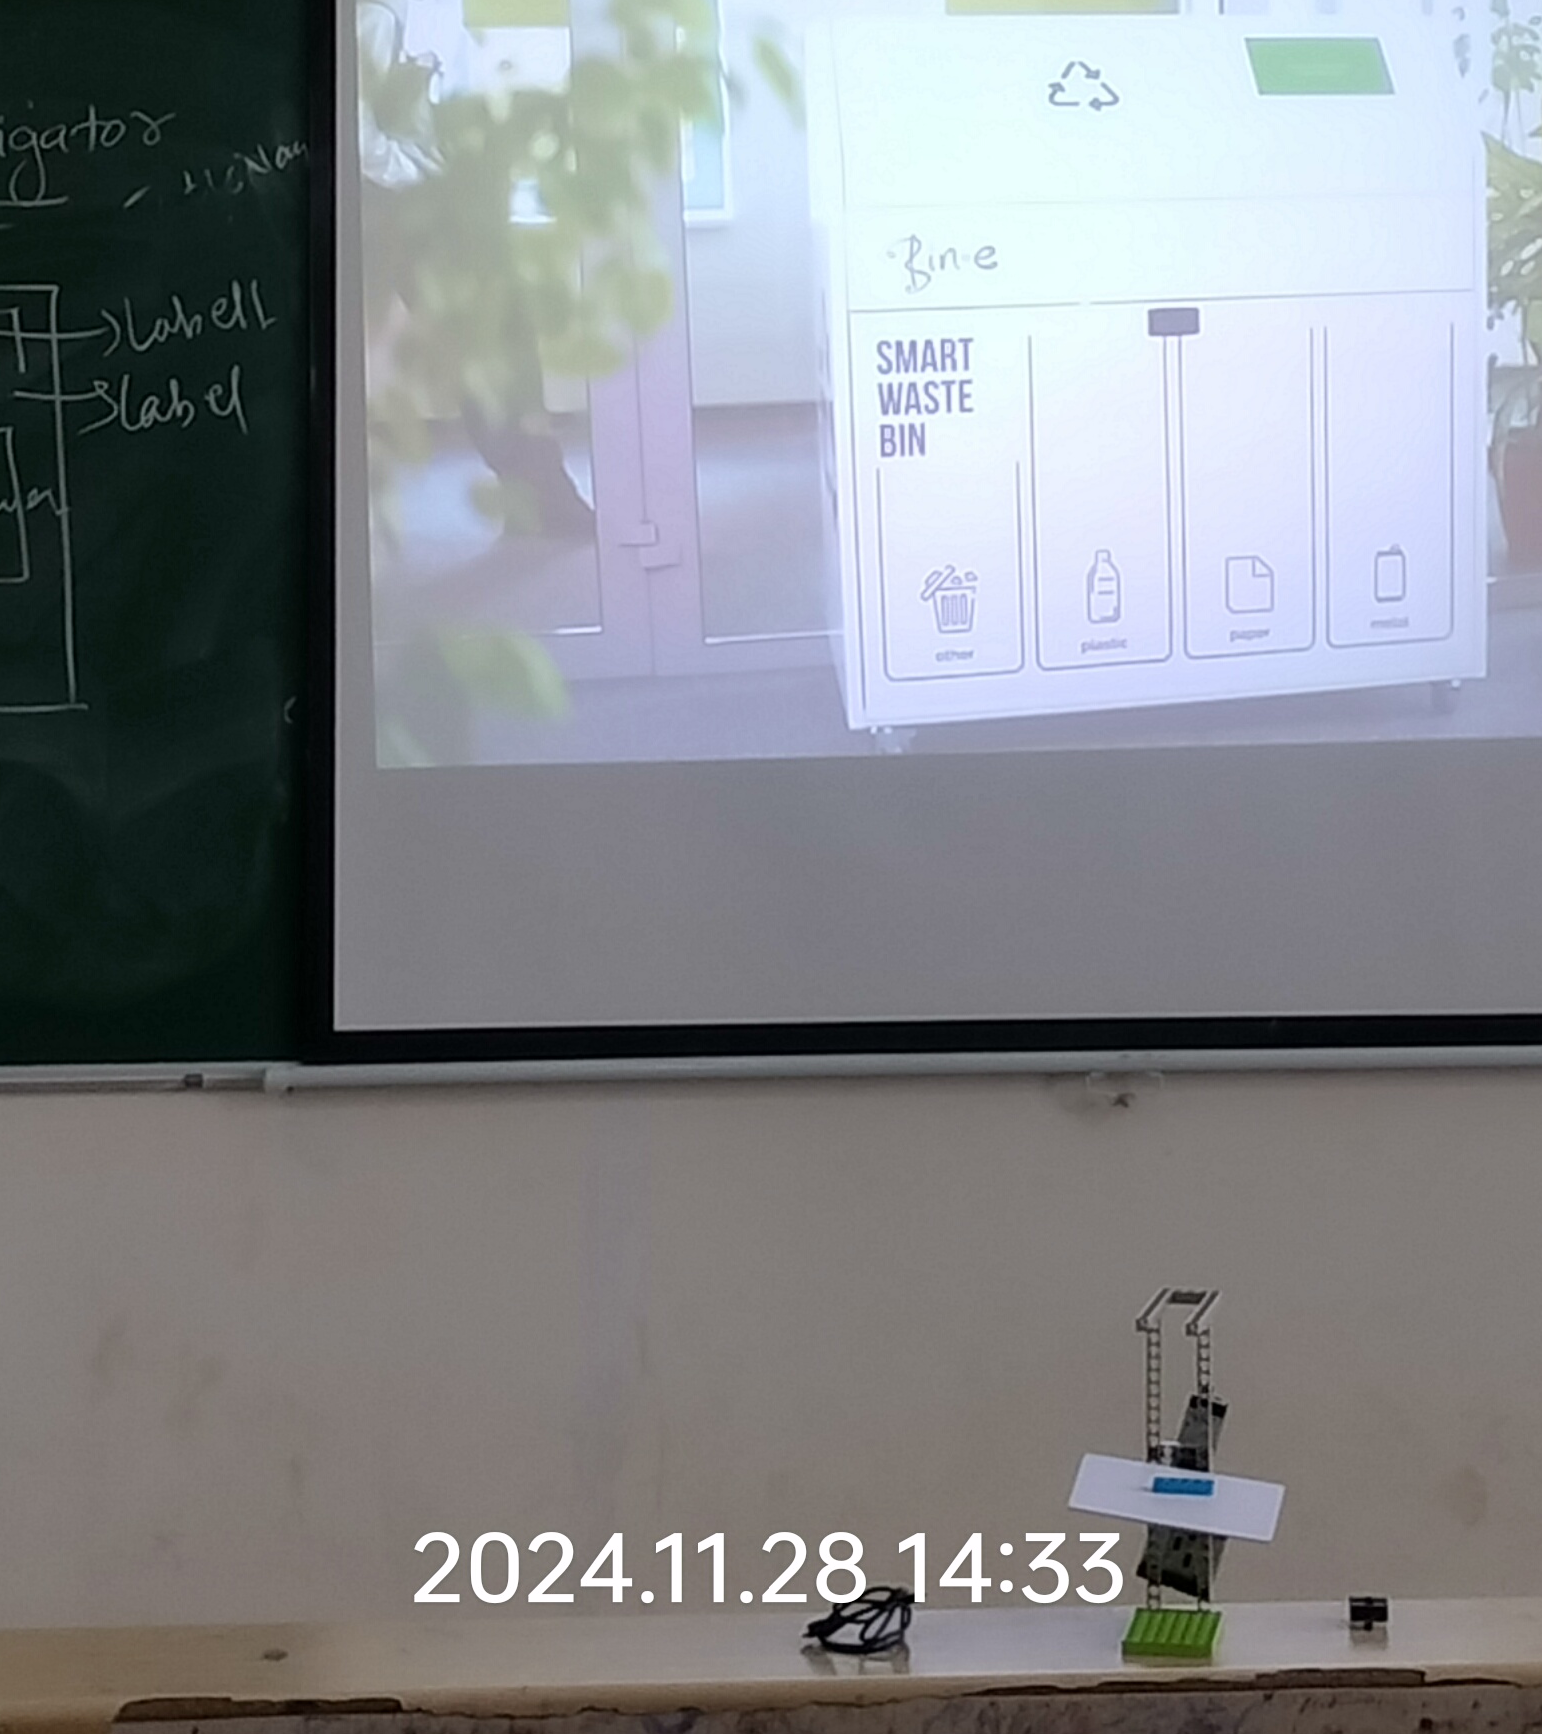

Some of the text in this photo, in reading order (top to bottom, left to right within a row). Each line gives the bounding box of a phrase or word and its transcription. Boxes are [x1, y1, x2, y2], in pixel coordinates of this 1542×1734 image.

[876, 337, 974, 375] SMART
[877, 378, 974, 416] WASTE
[879, 422, 926, 458] BIN
[935, 649, 975, 663] other
[1080, 637, 1128, 654] plastic
